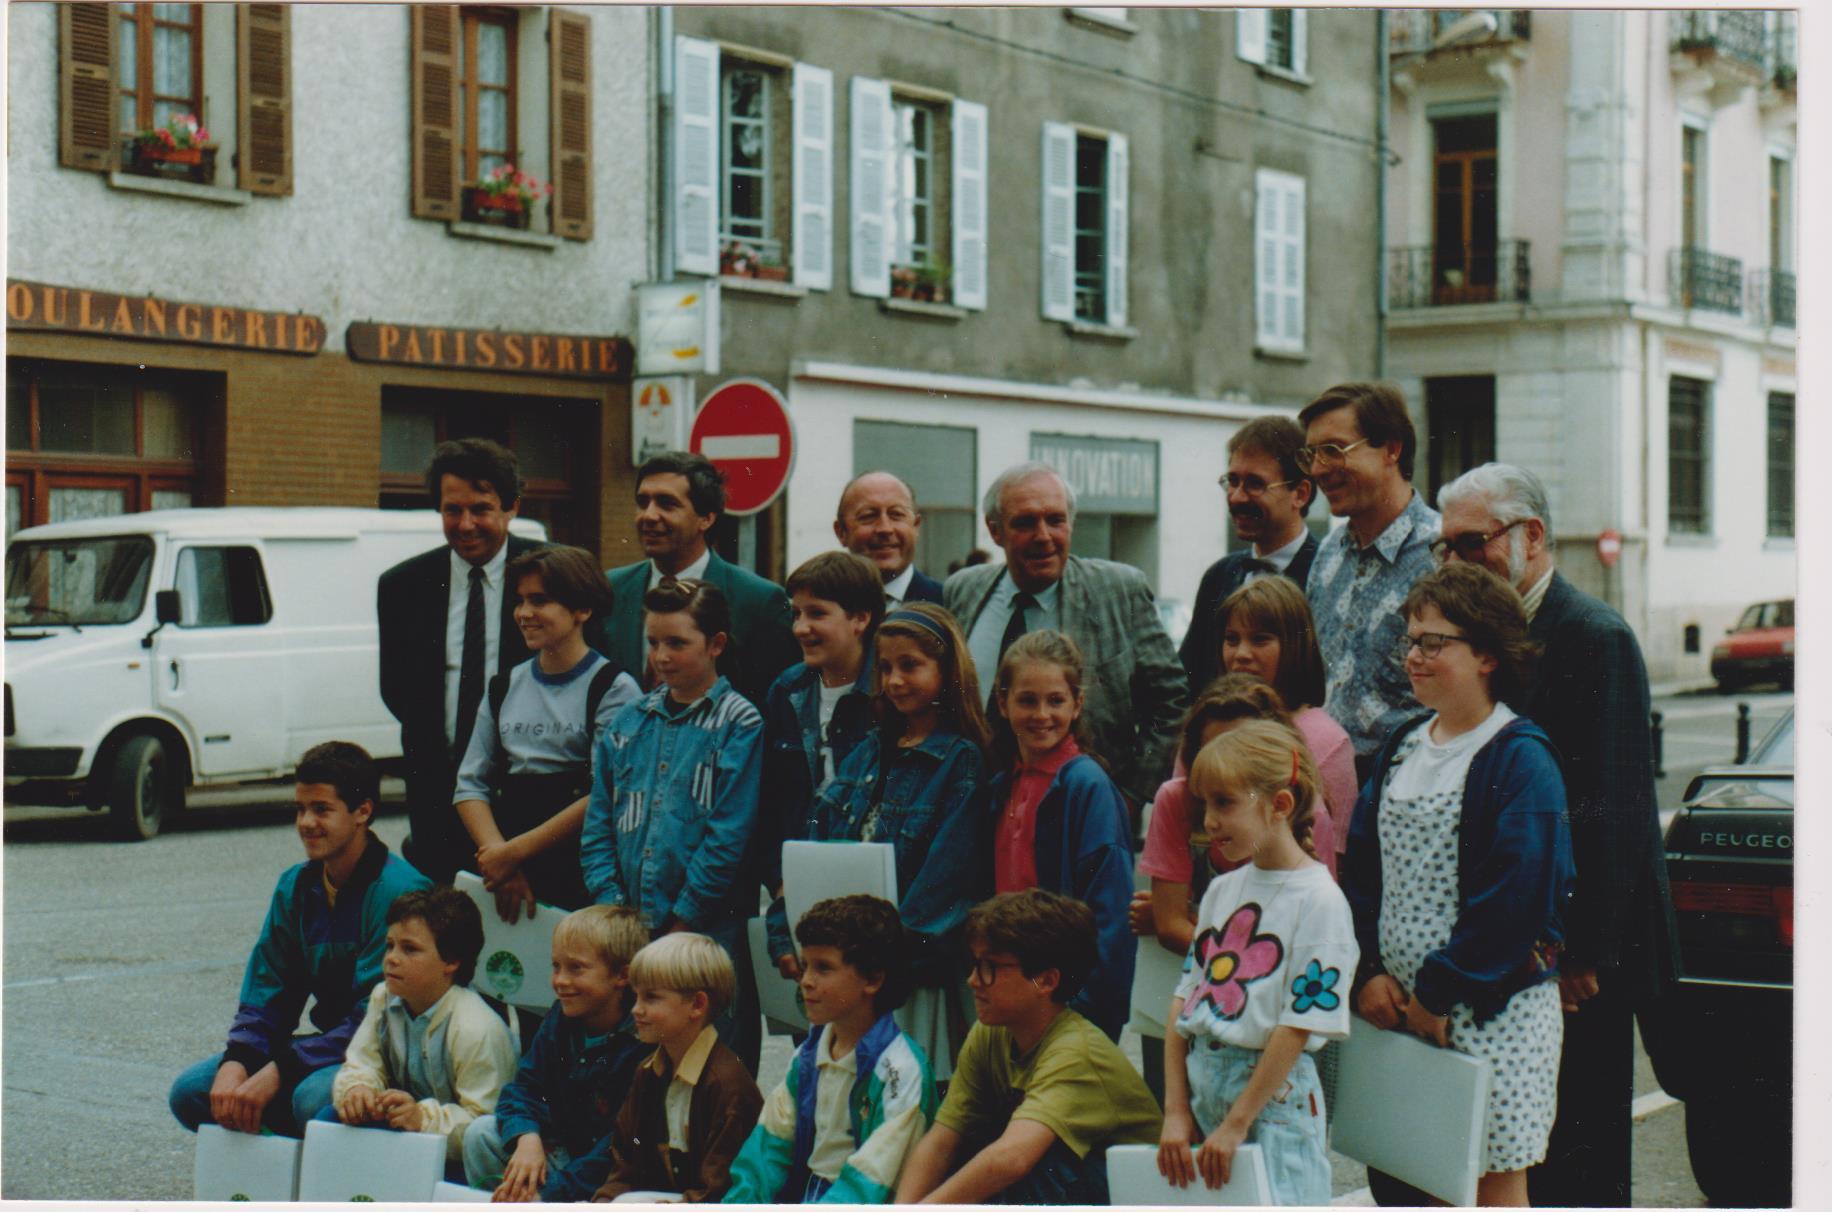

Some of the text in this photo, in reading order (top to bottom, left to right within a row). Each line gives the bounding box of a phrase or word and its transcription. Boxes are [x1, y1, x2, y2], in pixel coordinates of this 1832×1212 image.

[7, 283, 318, 352] OULANGERIE
[378, 325, 618, 373] PATISSERIE
[1700, 832, 1793, 848] PEUGEO
